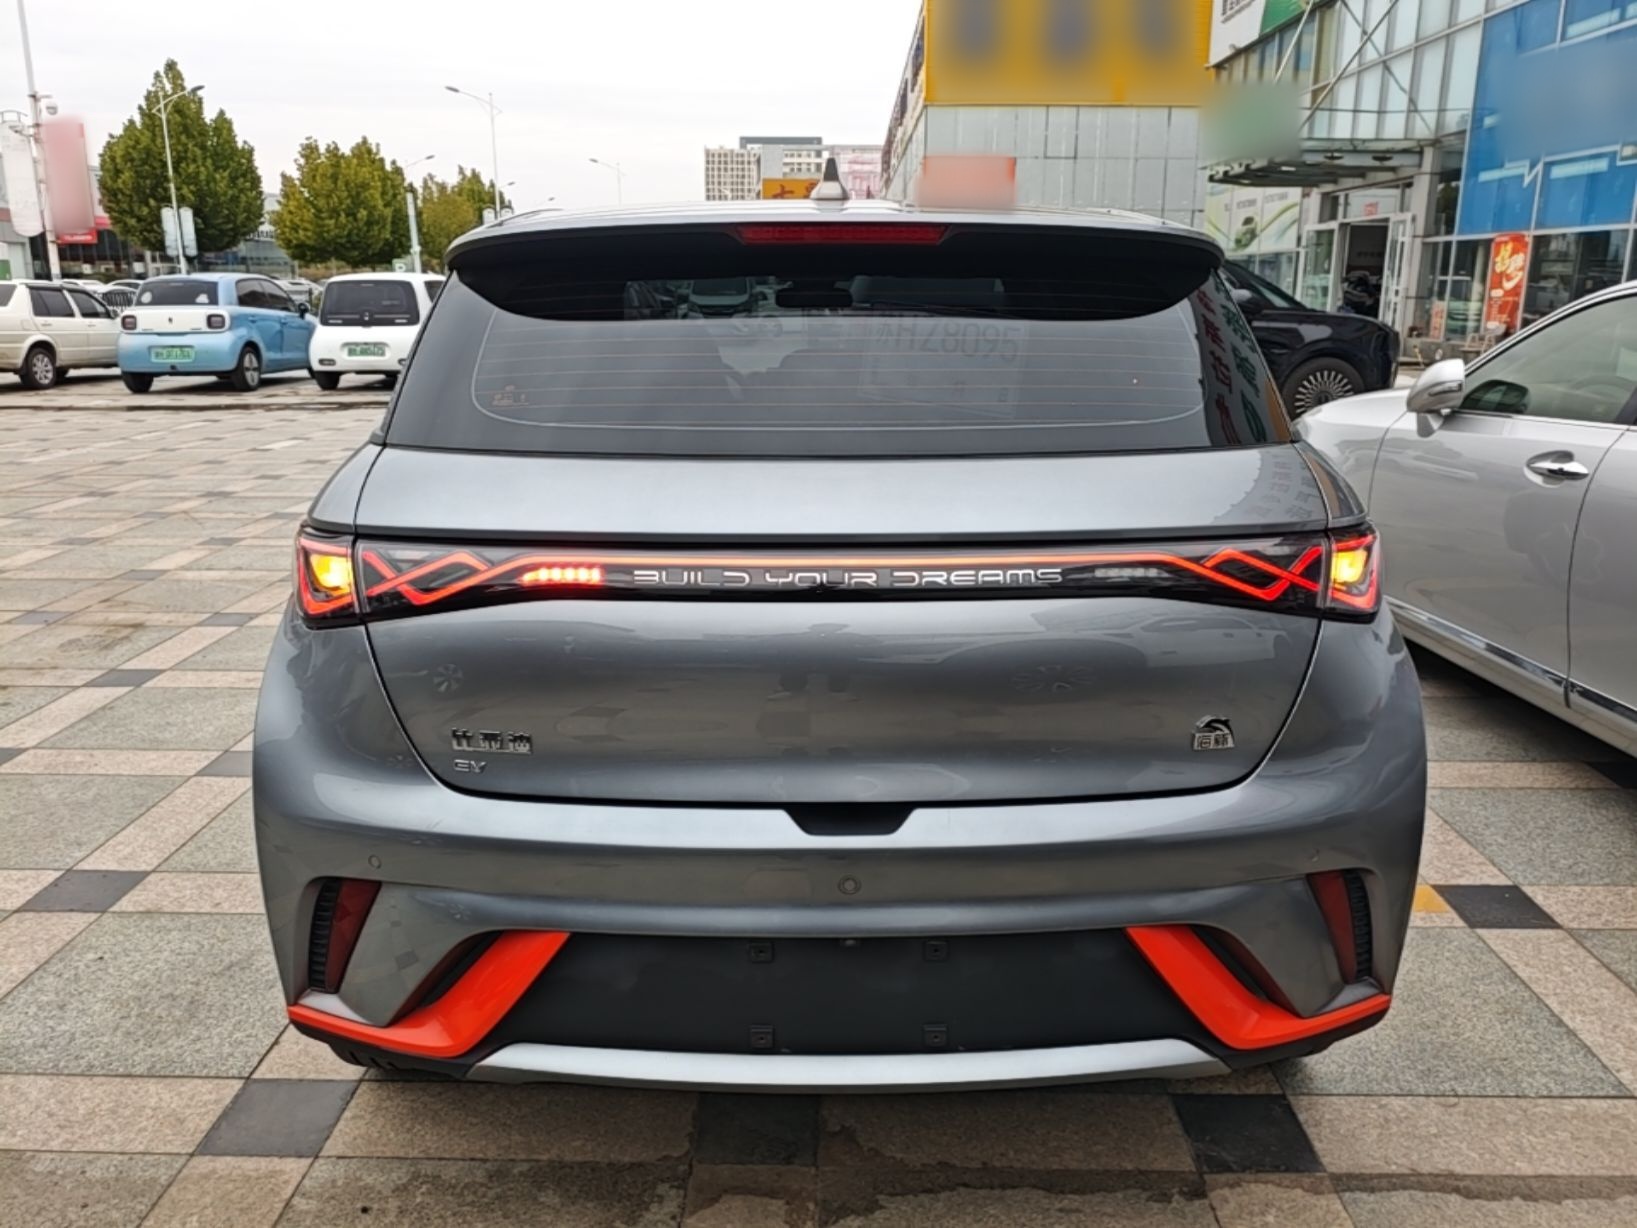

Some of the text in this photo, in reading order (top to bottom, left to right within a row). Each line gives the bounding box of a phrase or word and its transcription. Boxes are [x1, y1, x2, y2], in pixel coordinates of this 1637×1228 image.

[633, 568, 1064, 588] BUILD YOUR DREAMS
[454, 759, 487, 774] EV
